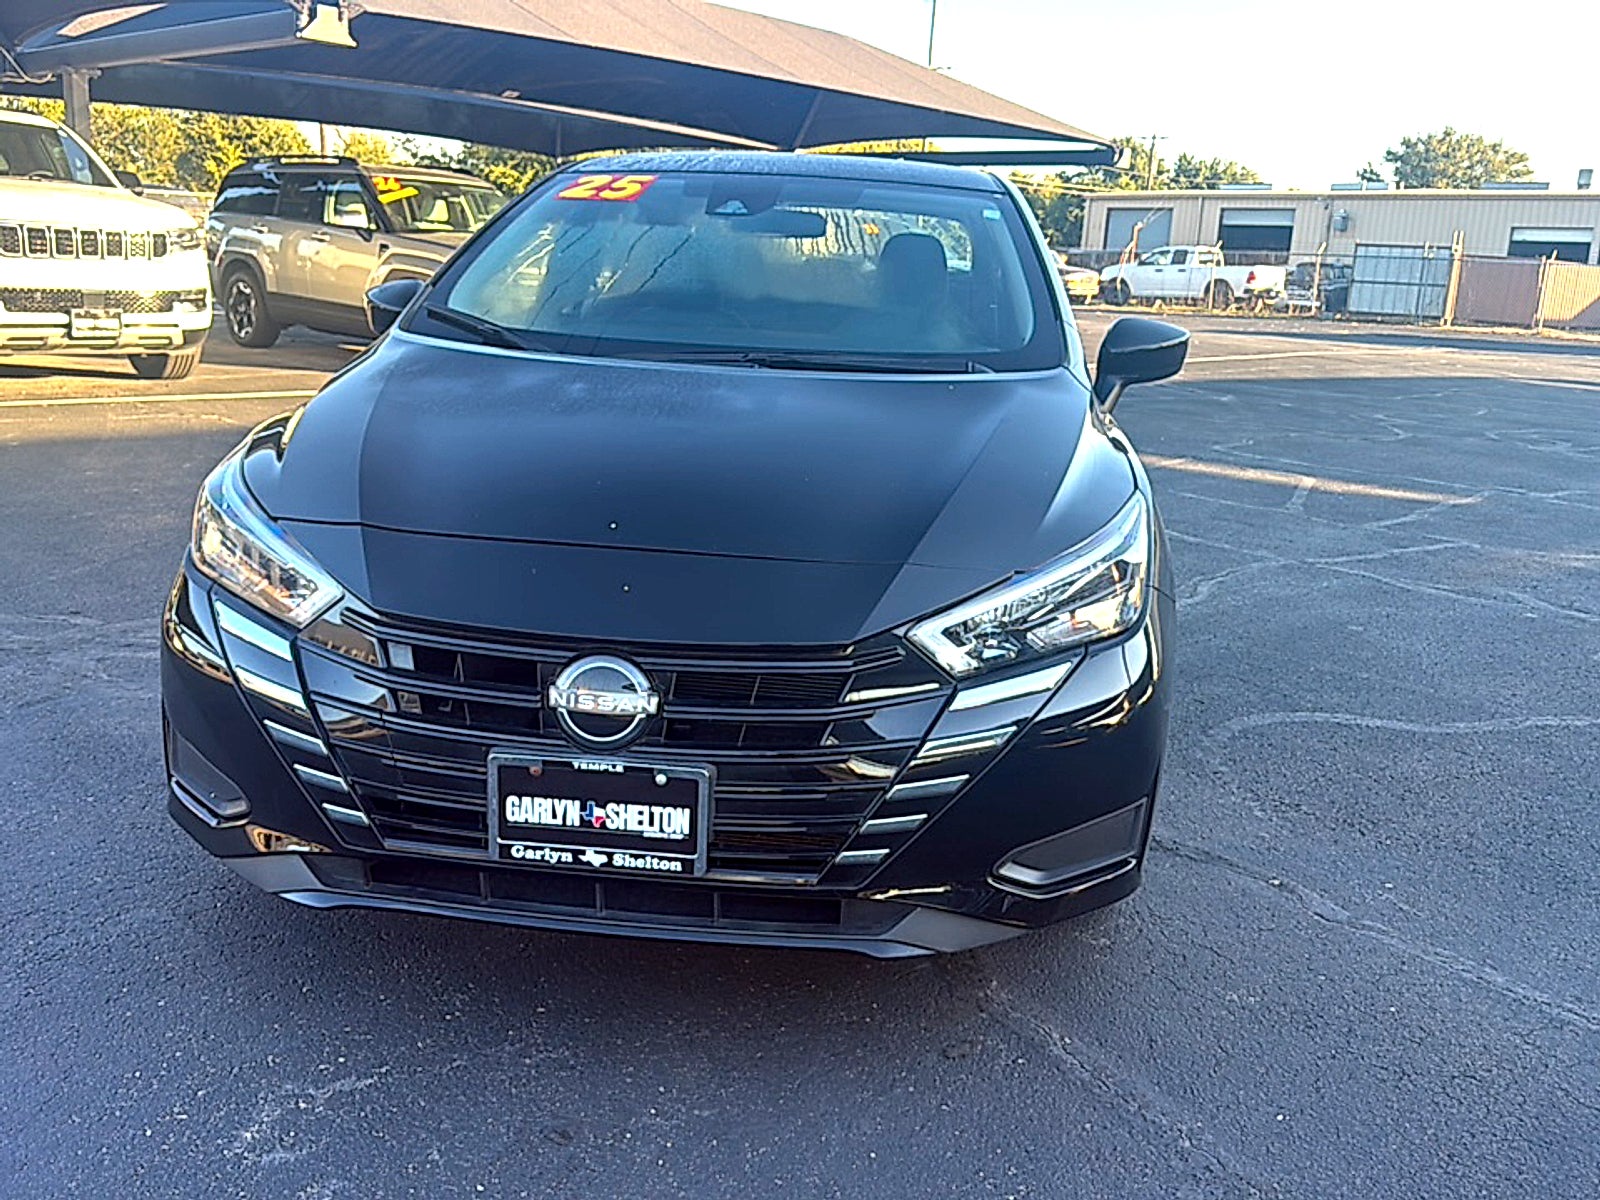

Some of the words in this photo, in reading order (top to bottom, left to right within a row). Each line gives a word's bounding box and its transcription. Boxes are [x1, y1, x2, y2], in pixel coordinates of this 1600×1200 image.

[558, 174, 655, 200] 25
[549, 686, 659, 714] NISSAN
[571, 761, 625, 773] TEMPLE
[505, 795, 581, 827] GARLYN
[605, 802, 691, 835] SHELTON
[510, 844, 573, 865] Garlyn
[612, 853, 683, 872] Shelton
